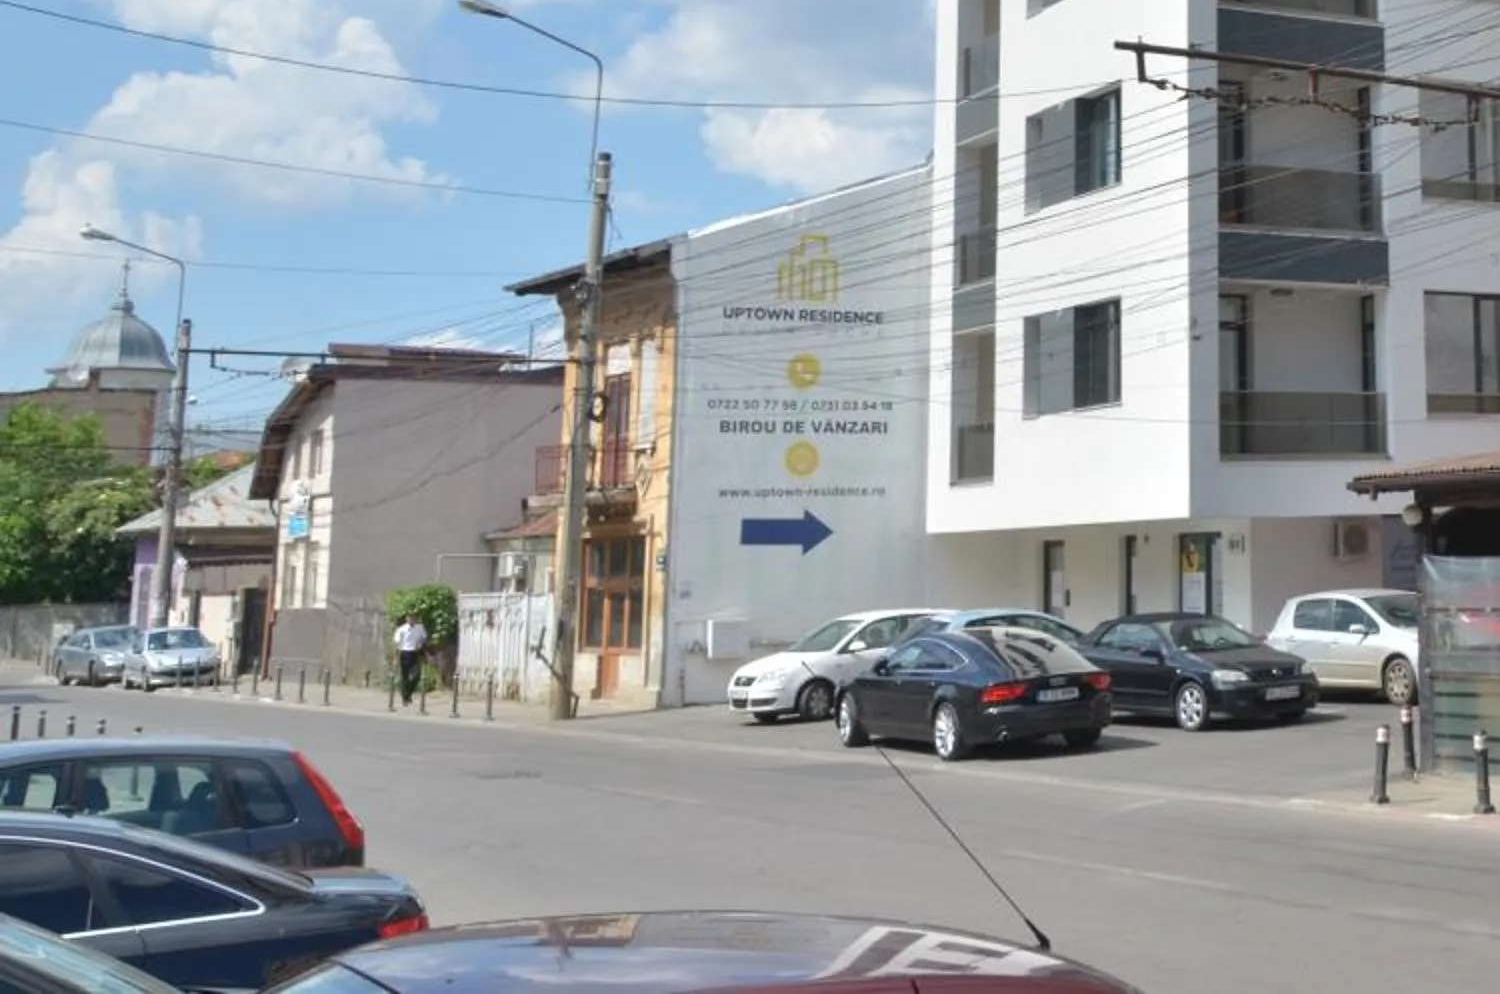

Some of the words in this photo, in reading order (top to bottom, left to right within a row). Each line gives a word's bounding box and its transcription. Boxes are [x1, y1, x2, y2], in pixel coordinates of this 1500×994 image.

[723, 307, 794, 321] UPTOWN
[799, 309, 884, 324] RESIDENCE
[719, 420, 777, 434] BIROU
[783, 421, 805, 434] DE
